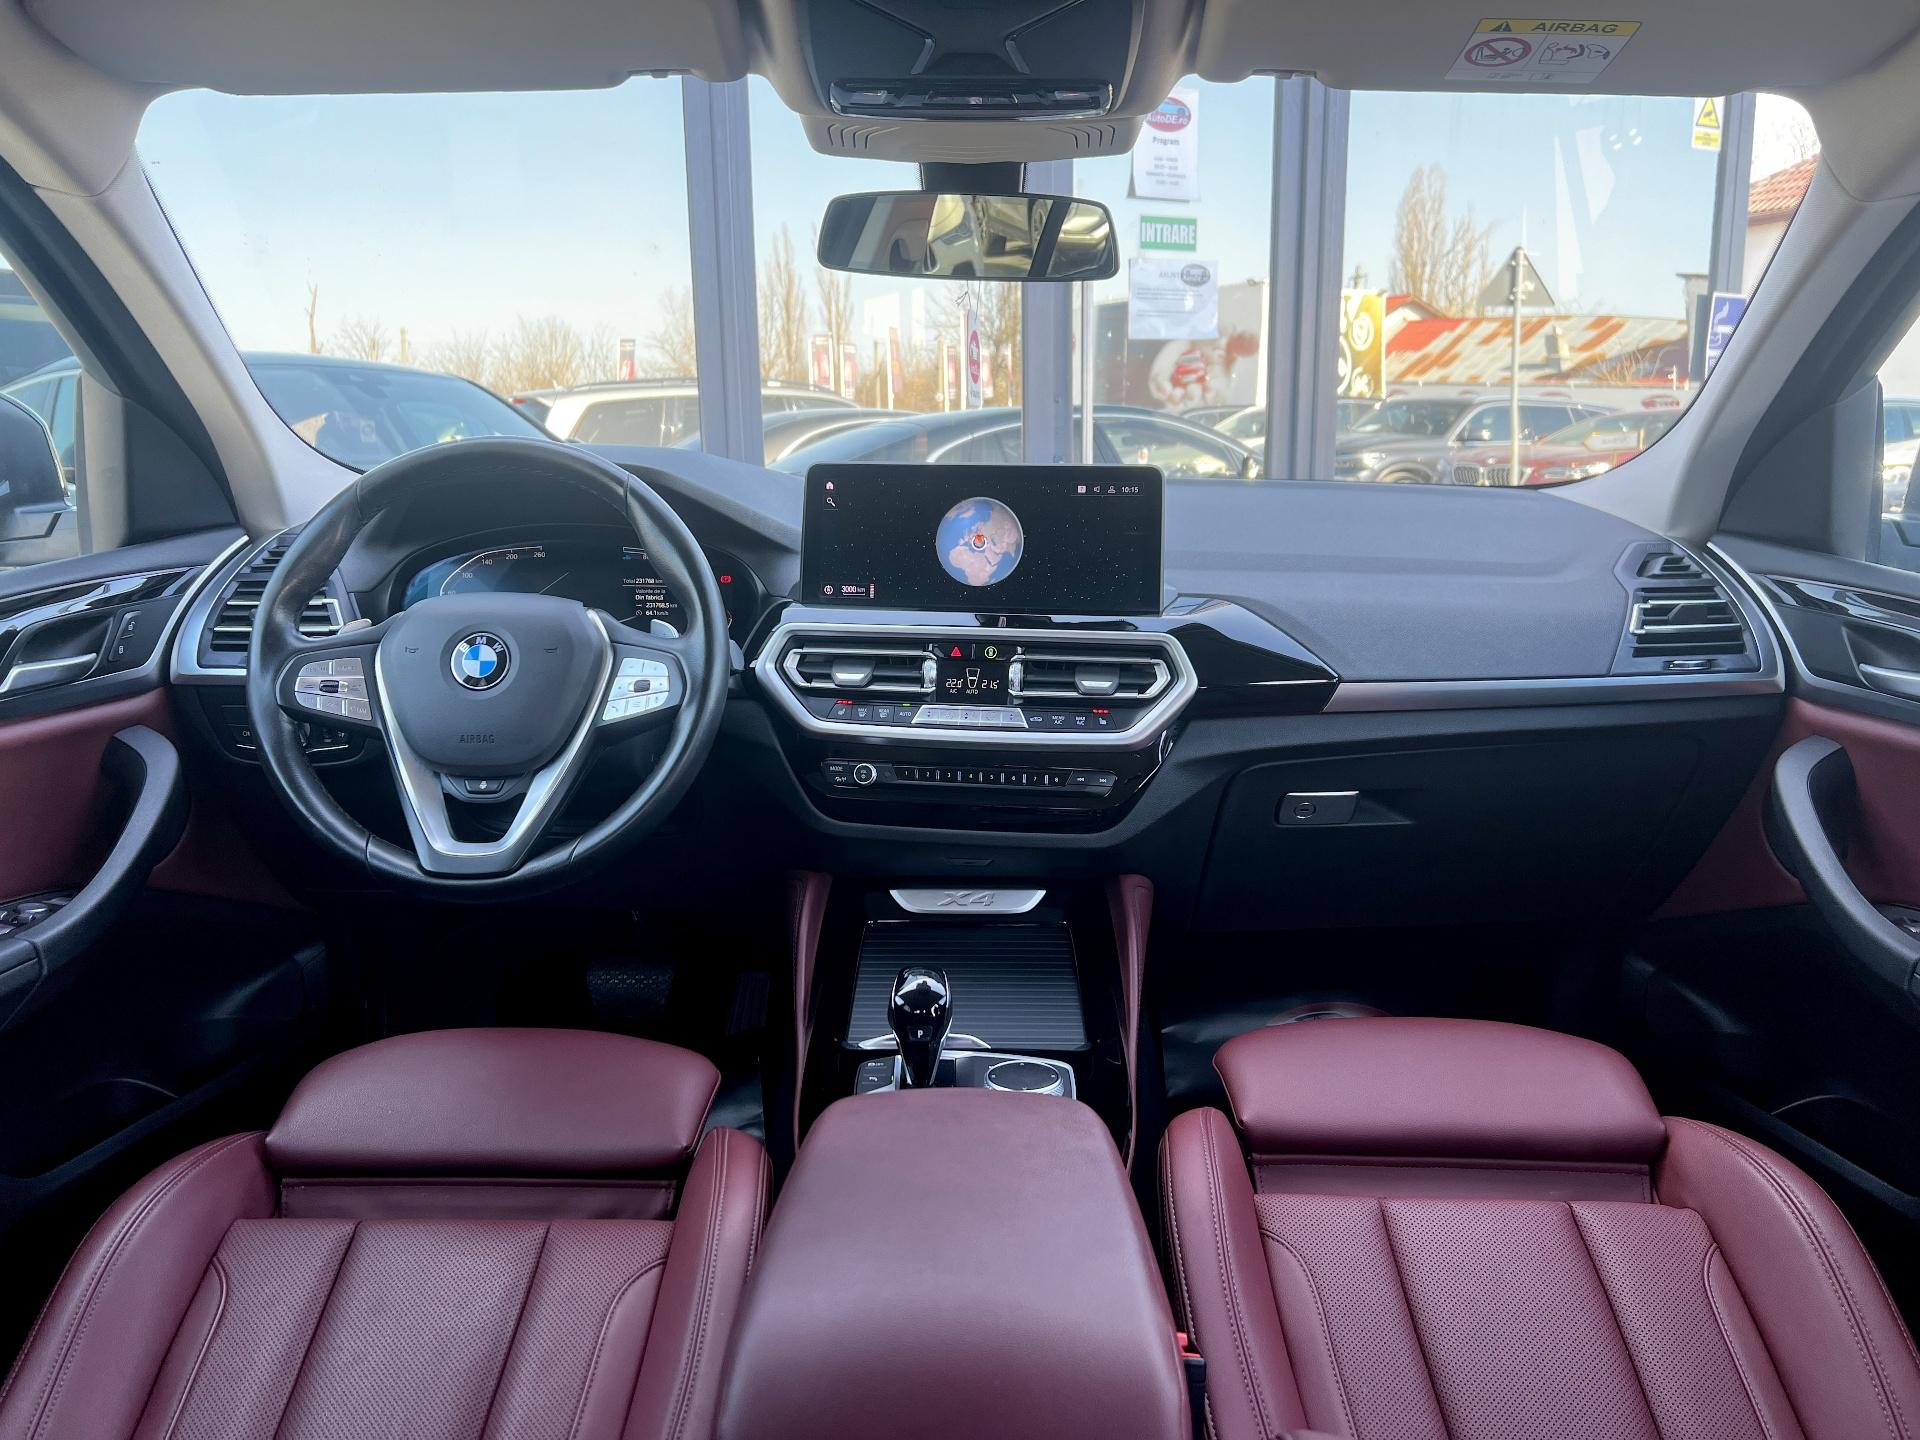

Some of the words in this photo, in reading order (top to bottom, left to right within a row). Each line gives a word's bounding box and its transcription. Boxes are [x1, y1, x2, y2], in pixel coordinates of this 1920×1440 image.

[1531, 22, 1618, 33] AIRBAG
[1141, 222, 1196, 245] INTRARE
[841, 585, 857, 593] 3000
[459, 636, 504, 653] BMW
[458, 734, 496, 744] AIRBAG
[937, 891, 994, 907] X4
[917, 1029, 924, 1039] P
